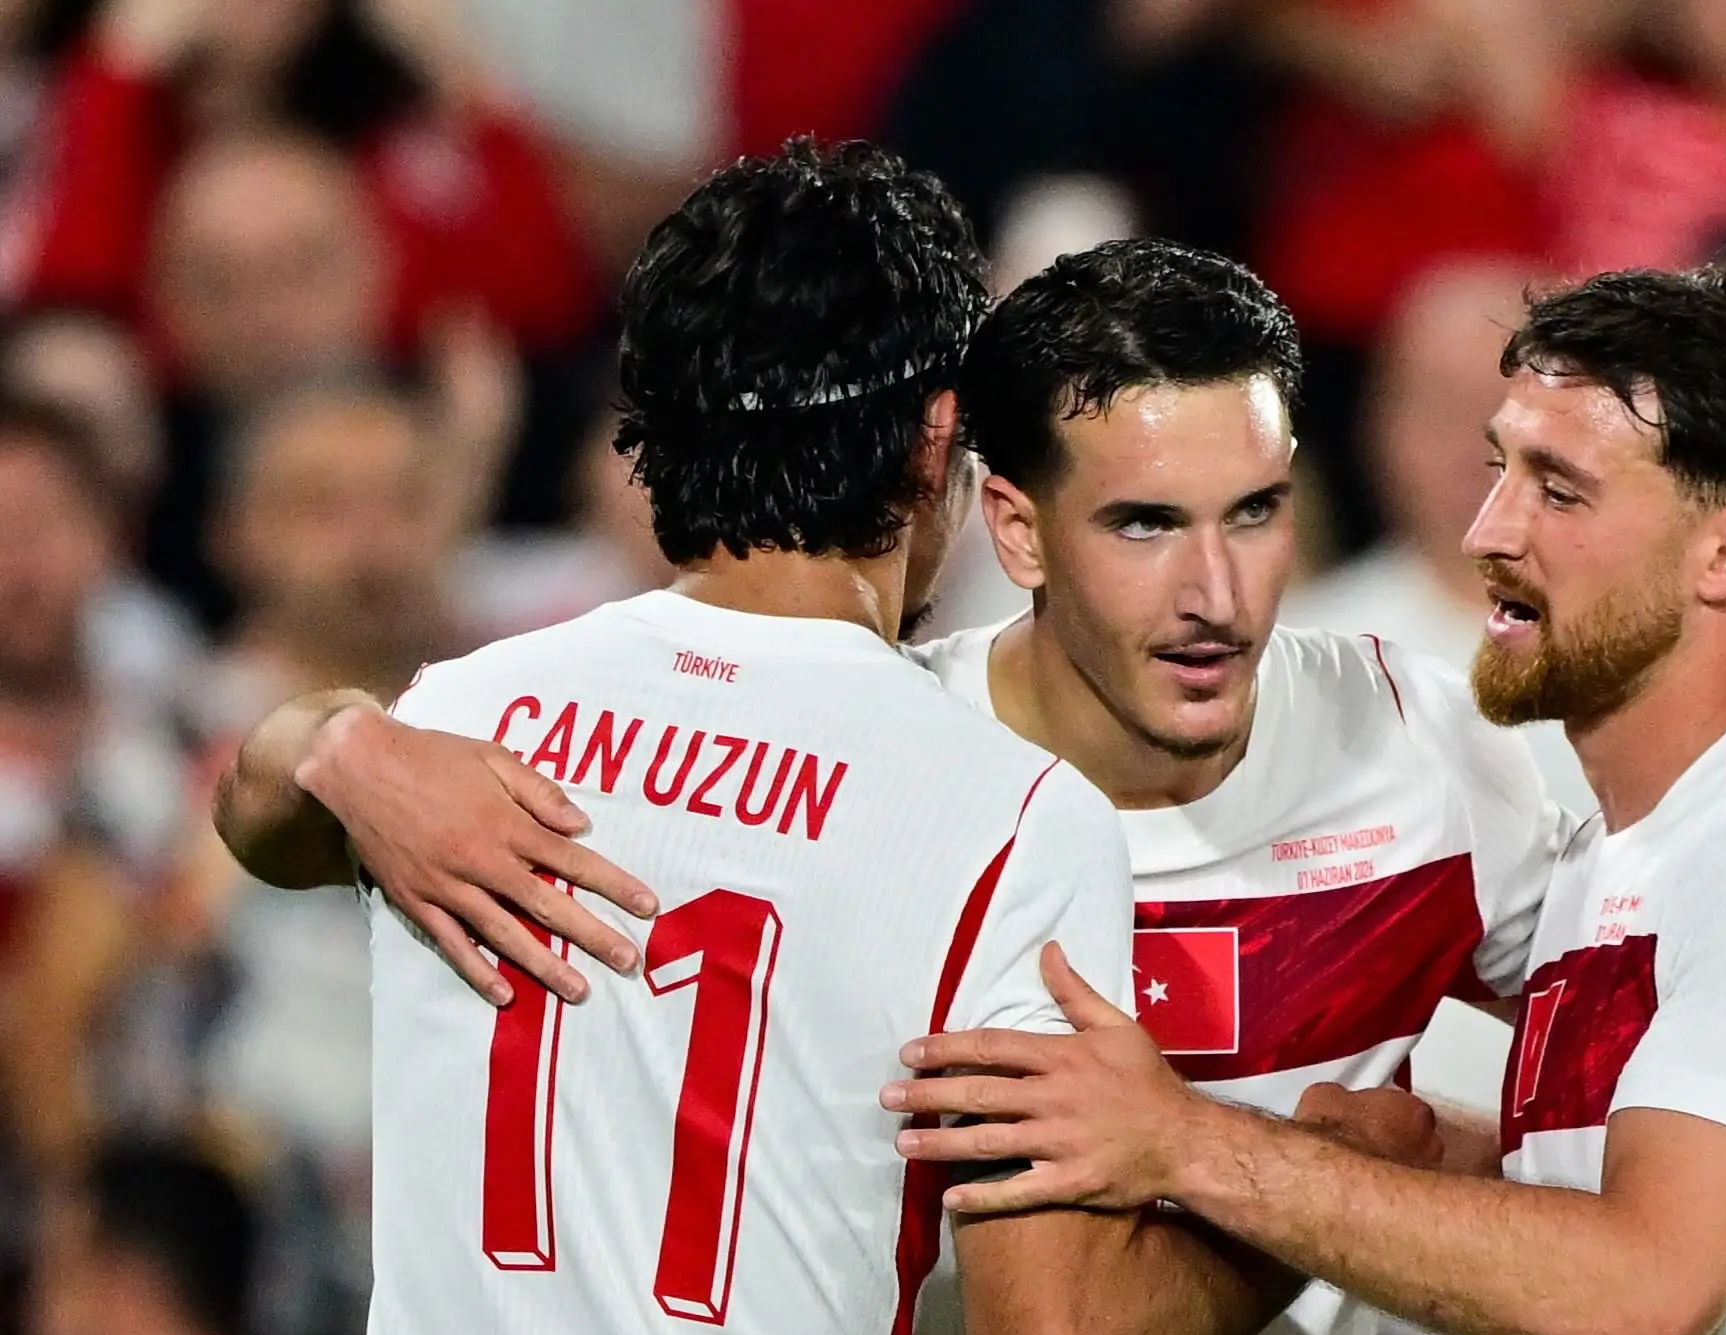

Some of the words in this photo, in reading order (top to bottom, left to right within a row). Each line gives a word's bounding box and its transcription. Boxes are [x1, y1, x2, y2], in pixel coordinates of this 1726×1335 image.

[672, 650, 740, 684] TÜRKİYE
[492, 695, 645, 795] CAN
[642, 725, 849, 842] UZUN
[470, 866, 784, 1327] 11
